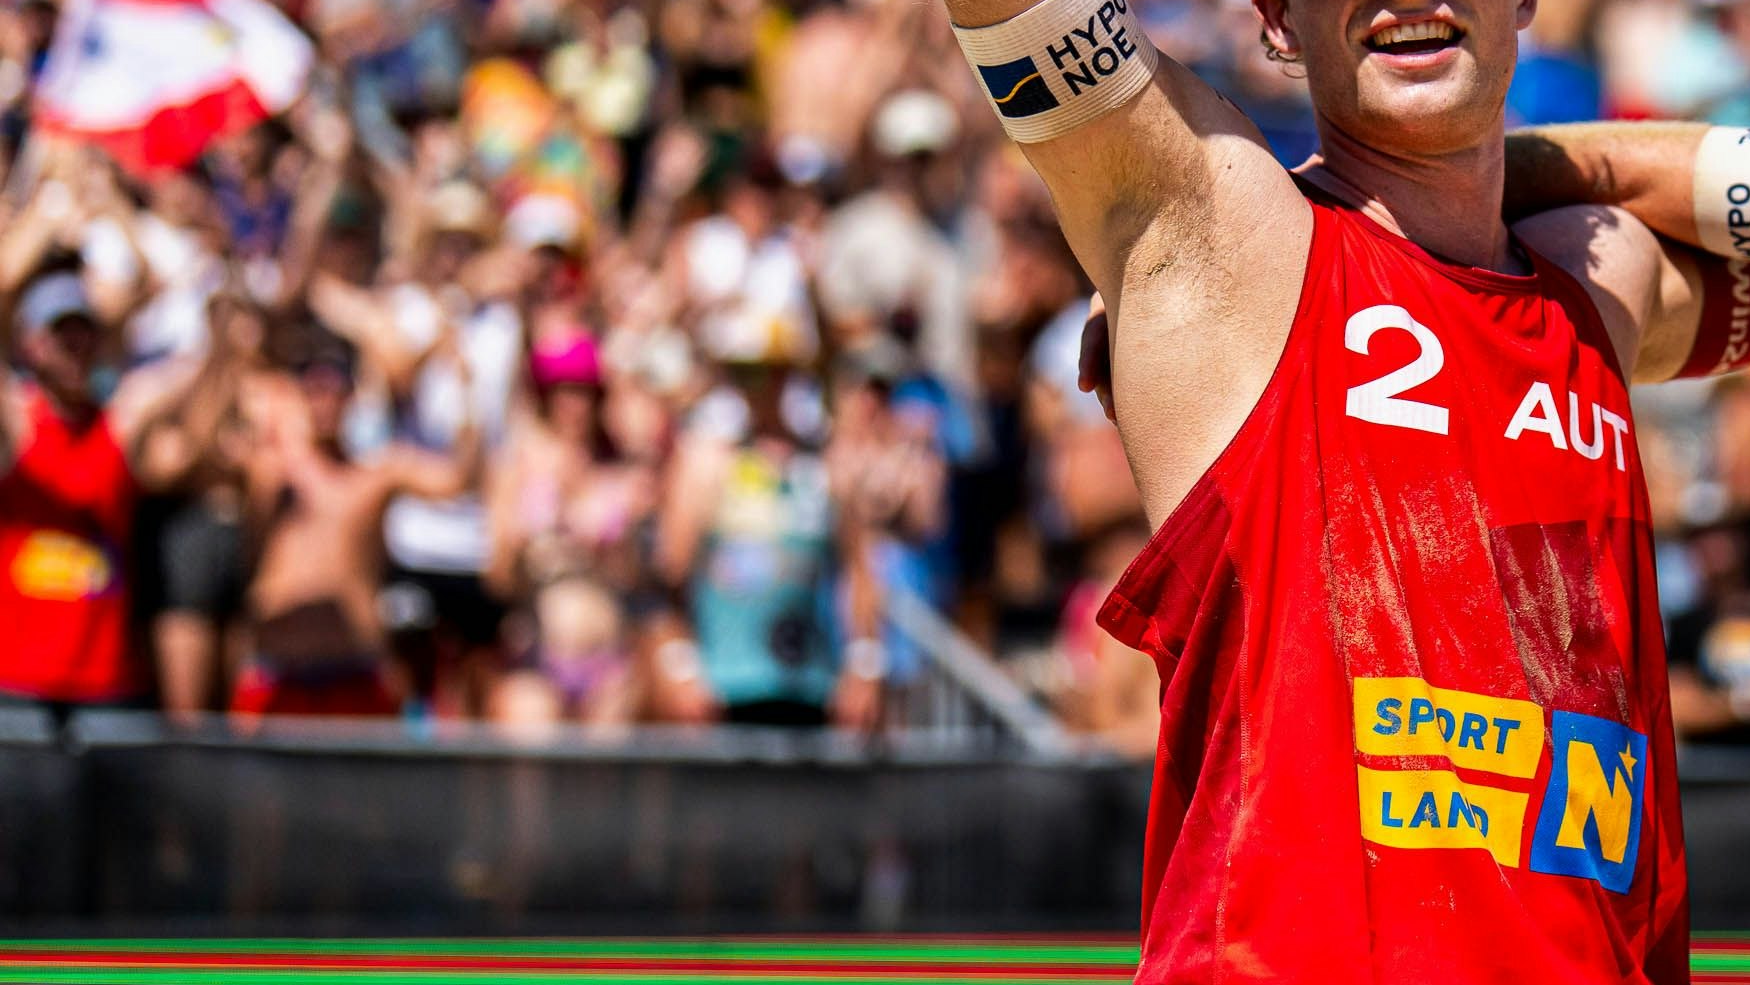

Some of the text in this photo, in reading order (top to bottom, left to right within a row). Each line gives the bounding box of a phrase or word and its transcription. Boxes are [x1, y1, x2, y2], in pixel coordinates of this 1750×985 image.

[1062, 26, 1137, 97] NOE
[1344, 304, 1450, 436] 2
[1503, 380, 1629, 472] AUT
[1372, 697, 1521, 755] SPORT
[1381, 790, 1489, 839] LAND
[1554, 739, 1633, 865] N
